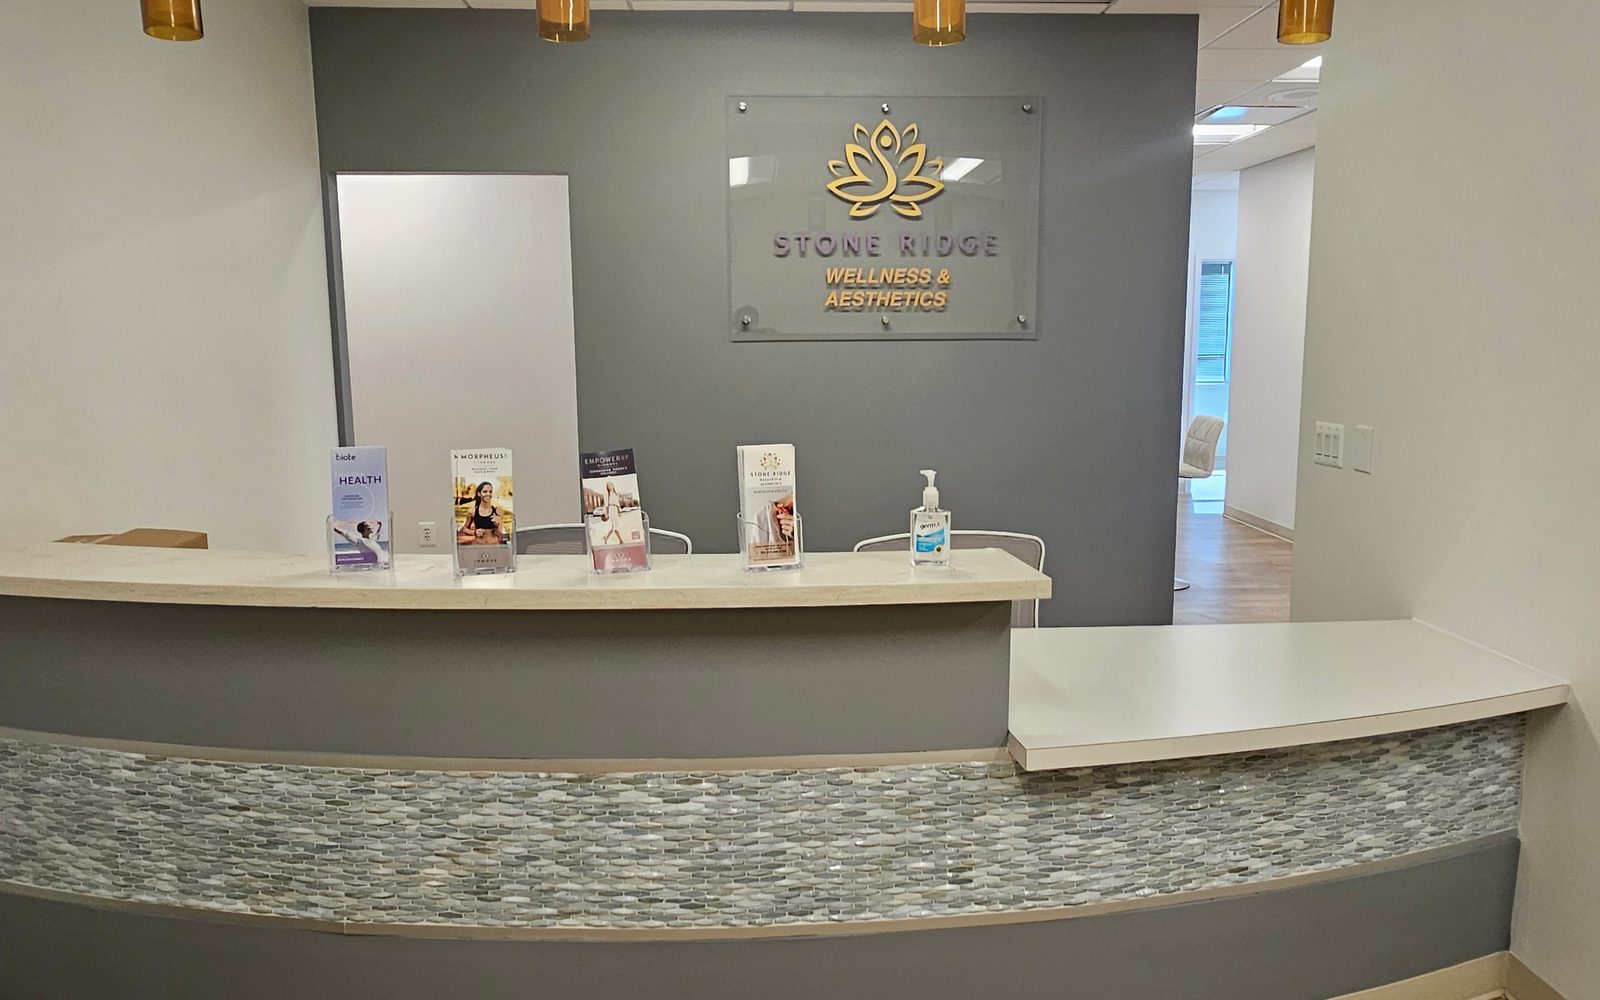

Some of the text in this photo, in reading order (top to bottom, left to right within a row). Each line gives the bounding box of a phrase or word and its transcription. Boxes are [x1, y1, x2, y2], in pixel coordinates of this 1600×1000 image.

[774, 232, 1000, 256] STONE RIDGE
[826, 267, 951, 285] WELLNESS &
[824, 290, 948, 308] AESTHETICS
[335, 452, 356, 461] biote
[339, 475, 382, 485] HEALTH
